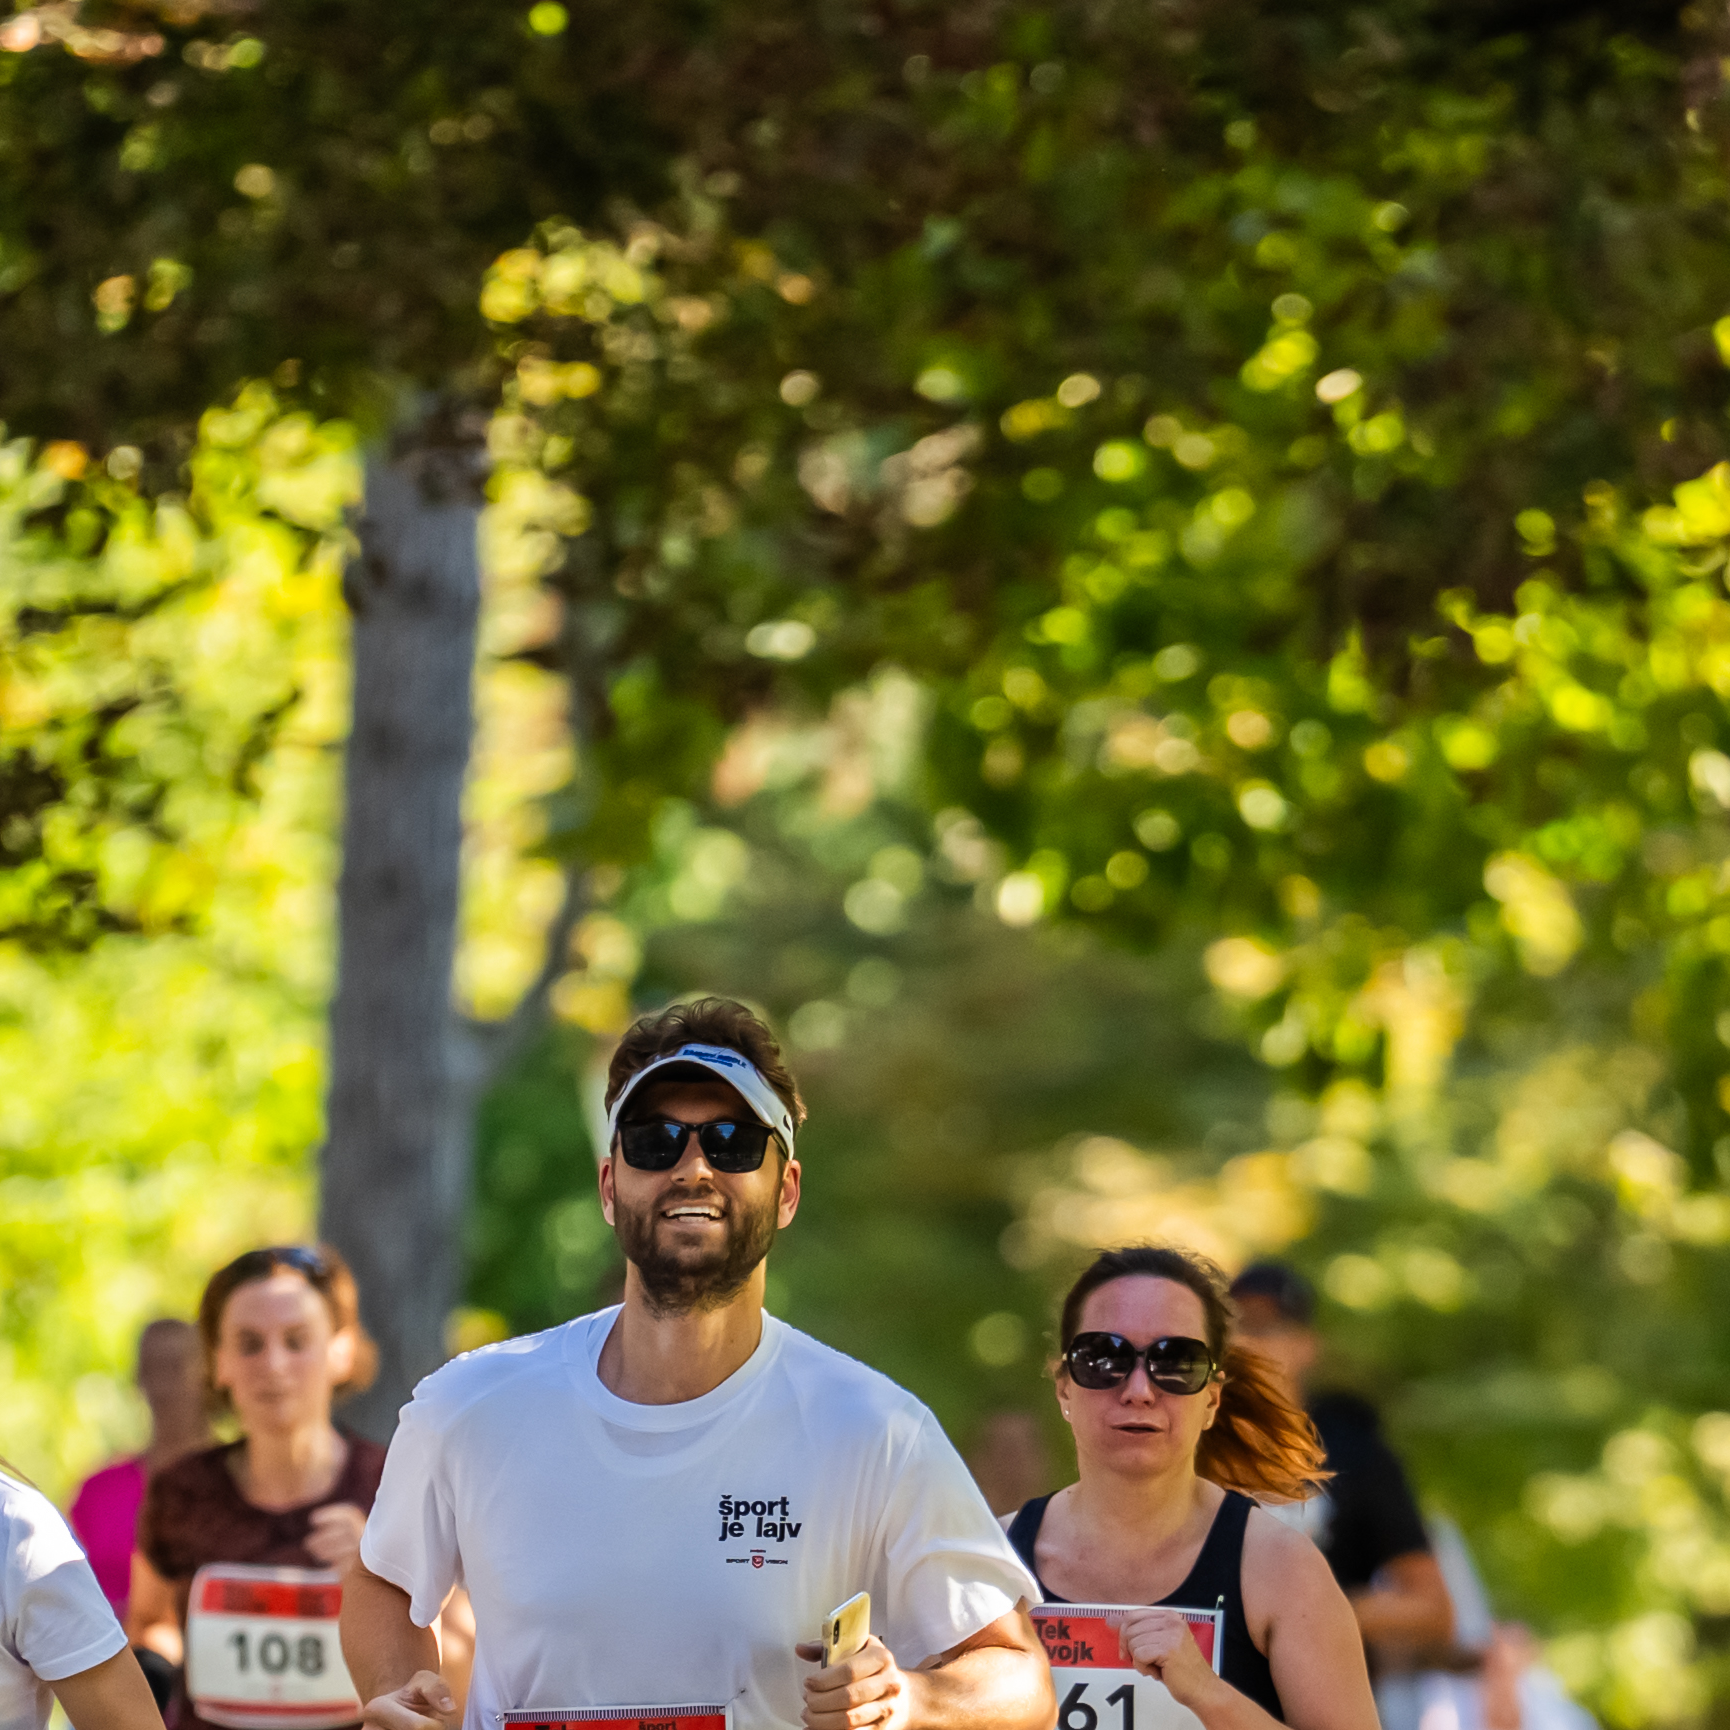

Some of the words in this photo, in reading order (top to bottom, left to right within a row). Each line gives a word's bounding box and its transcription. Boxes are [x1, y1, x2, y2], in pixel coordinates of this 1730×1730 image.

[718, 1494, 790, 1521] šport
[718, 1516, 745, 1542] je
[756, 1516, 803, 1543] lajv
[1033, 1618, 1072, 1641] Tek
[226, 1631, 326, 1677] 108
[1042, 1640, 1095, 1664] vojk
